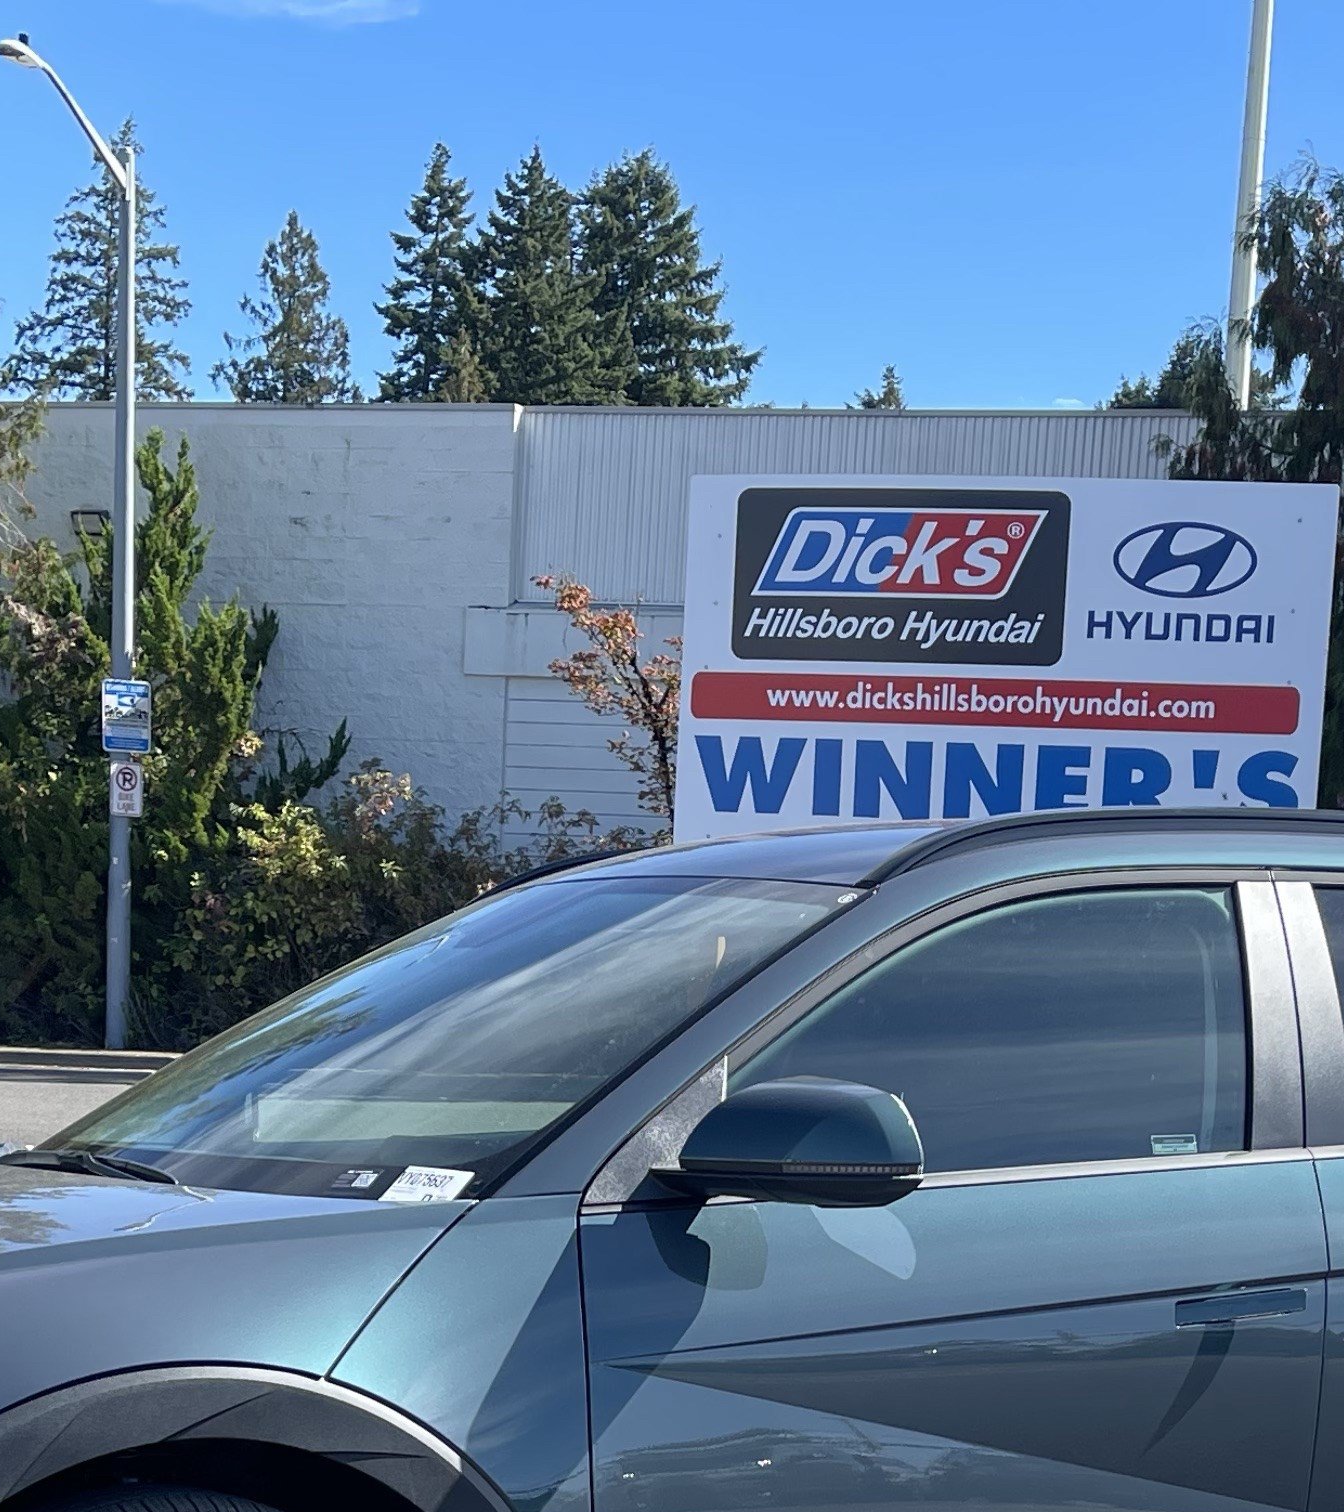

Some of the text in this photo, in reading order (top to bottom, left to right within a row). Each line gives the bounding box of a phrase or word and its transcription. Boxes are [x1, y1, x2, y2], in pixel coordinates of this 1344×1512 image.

[743, 607, 1045, 649] Hillsboro Hyundai
[1086, 610, 1275, 644] HYUNDAI
[766, 682, 1216, 722] www.dickshillsborohyundai.com
[694, 734, 1300, 820] WINNER'S
